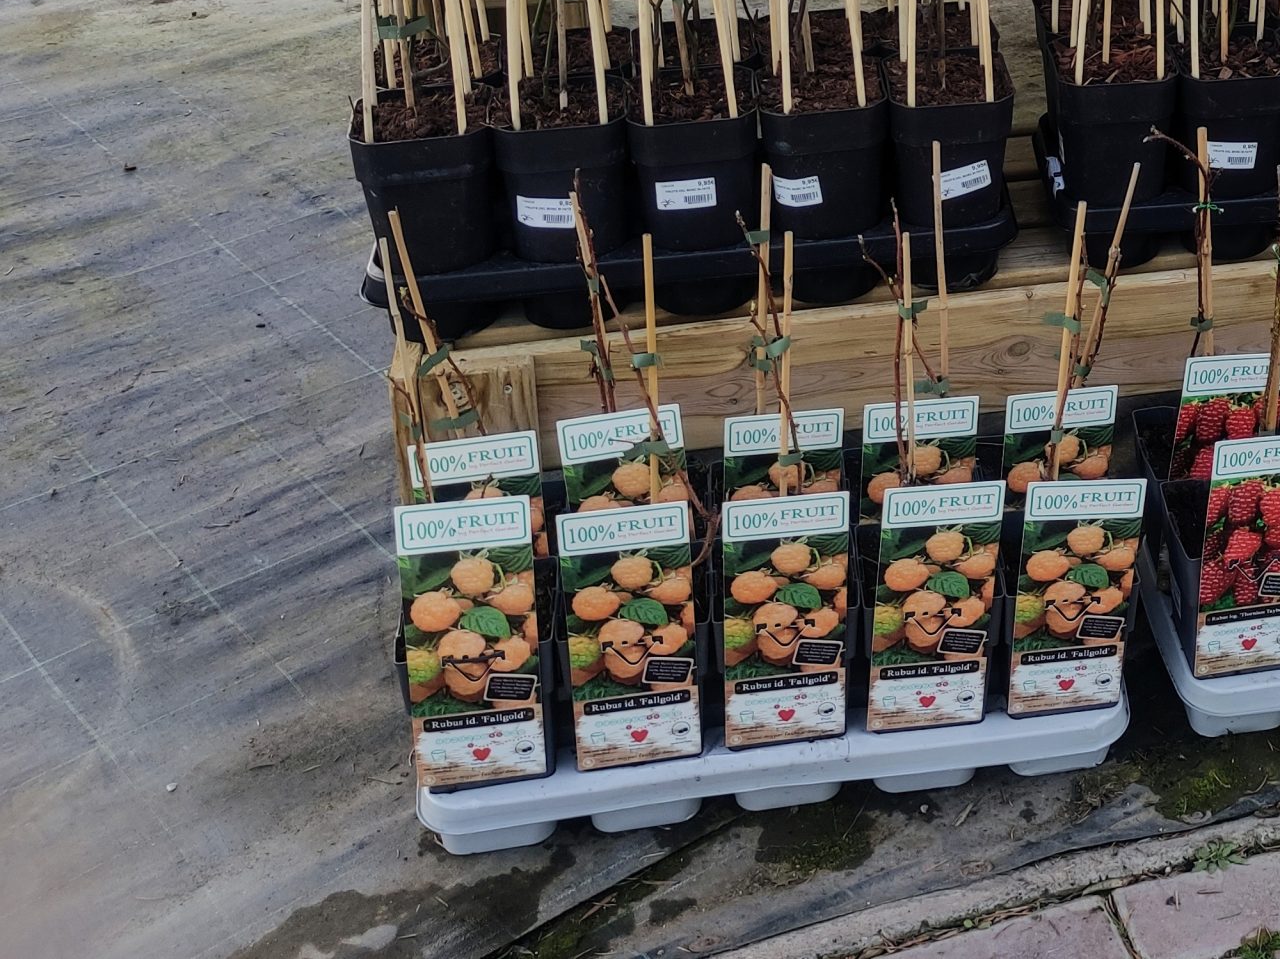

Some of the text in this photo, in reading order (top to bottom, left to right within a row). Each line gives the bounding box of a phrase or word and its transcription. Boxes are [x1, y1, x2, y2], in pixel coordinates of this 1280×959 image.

[1193, 366, 1269, 385] 100% FRUI
[916, 408, 969, 423] FRUIT
[1016, 398, 1108, 422] 100% RUIT
[570, 429, 613, 452] 100%
[735, 428, 776, 446] 100%
[430, 444, 528, 474] 00% FRUIT
[1222, 450, 1260, 468] 100%
[894, 493, 996, 518] 100% FRUIT
[1036, 491, 1136, 510] 100% FRUIT
[408, 510, 520, 541] 100% FRUIT
[734, 505, 839, 530] 100% FRUIT
[568, 515, 678, 544] 100% FRUIT
[1028, 647, 1111, 663] Rubus id. 'Fallgold'
[886, 660, 972, 678] Rubus id. 'Fallgold'
[742, 674, 831, 692] Rubus id. 'Fallgold'
[591, 693, 682, 713] Rubus id. 'Fallgold'
[432, 710, 526, 730] Rubus id. 'Fallgold'
